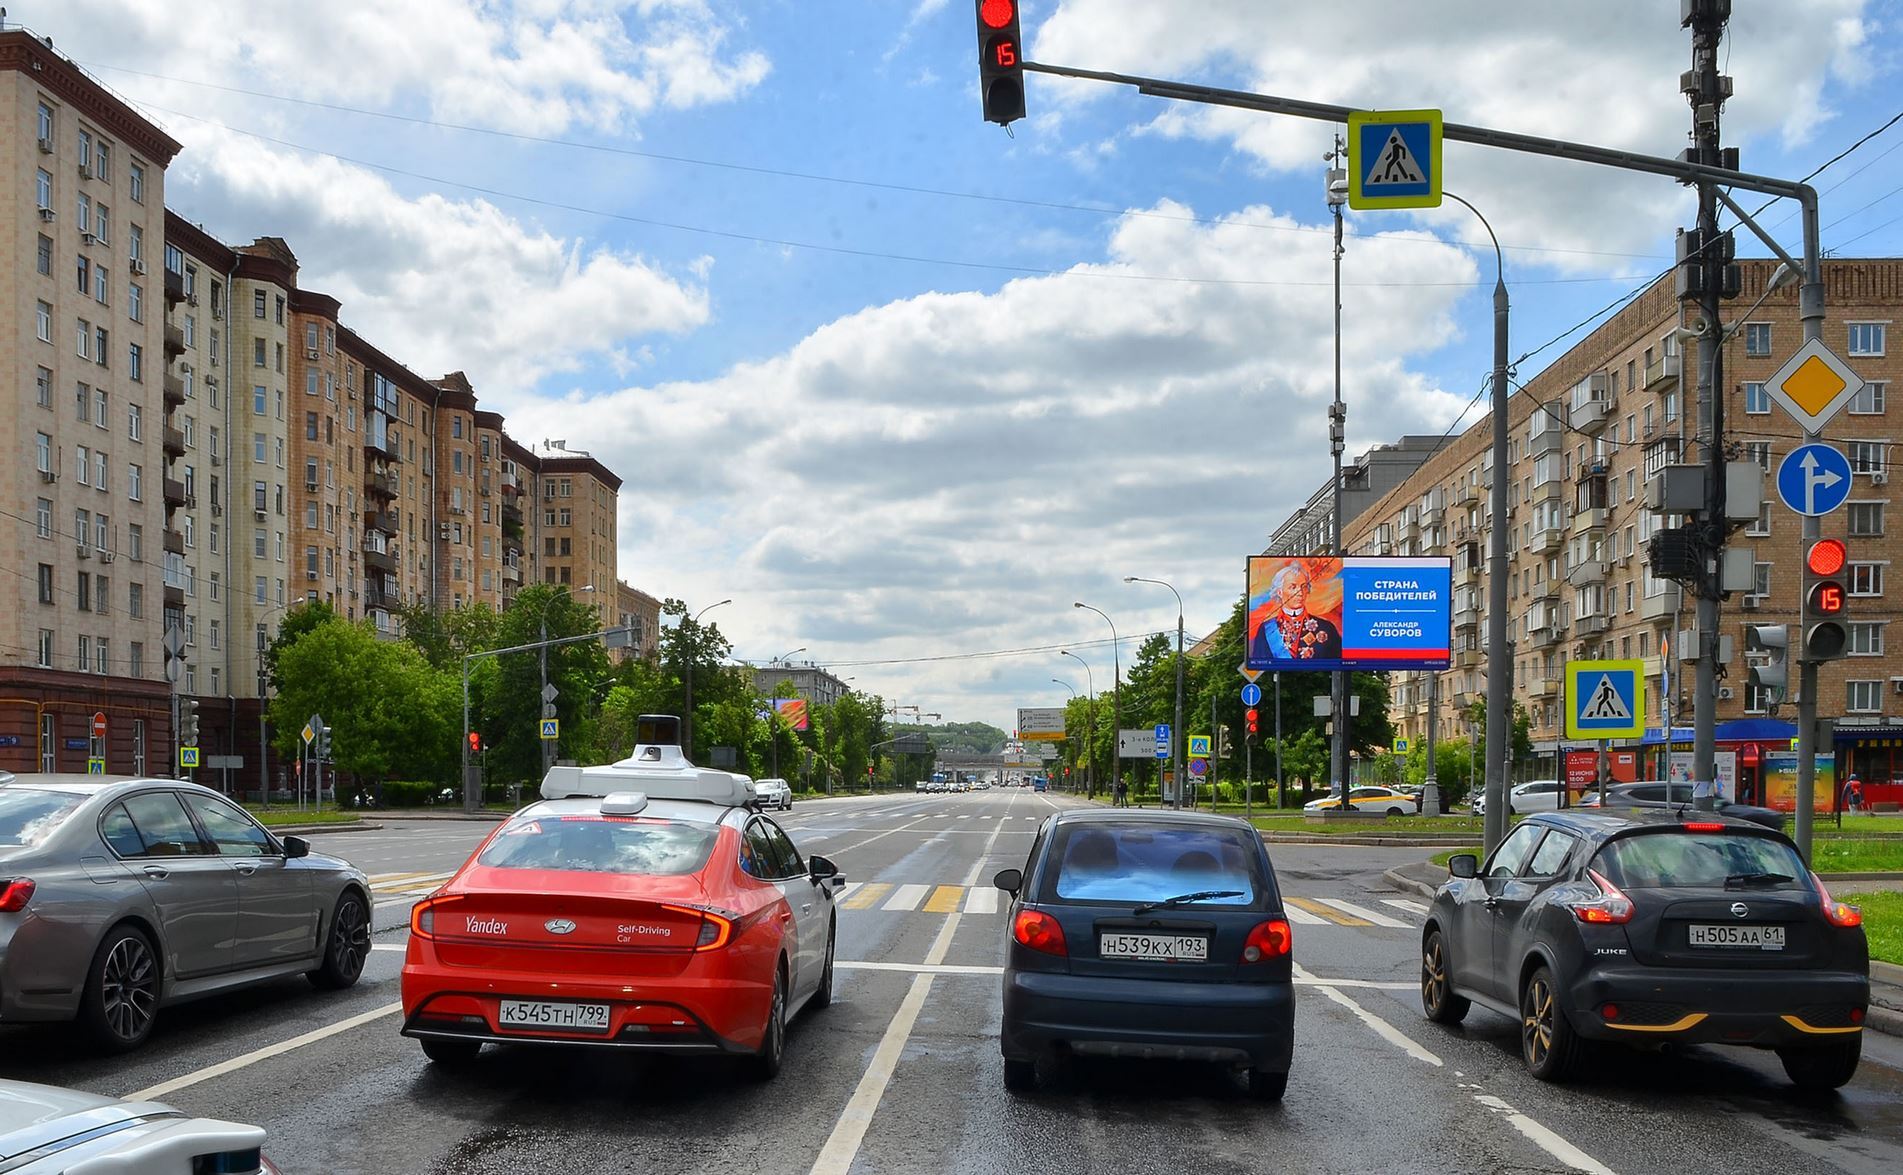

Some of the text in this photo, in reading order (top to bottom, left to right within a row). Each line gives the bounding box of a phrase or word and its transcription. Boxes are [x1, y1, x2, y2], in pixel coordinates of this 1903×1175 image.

[996, 43, 1015, 65] 15
[1374, 580, 1419, 589] СТРАНА
[1356, 590, 1437, 601] ПОБЕДИТЕЛЕЙ
[1822, 589, 1840, 610] 15
[1369, 629, 1422, 637] СУВОРОВ
[466, 916, 508, 935] Yandex
[617, 924, 671, 936] Self-Driving
[617, 935, 631, 943] Car
[1763, 928, 1780, 940] 61
[1177, 939, 1202, 951] 193
[1593, 948, 1627, 956] JUKE
[578, 1006, 604, 1020] 799
